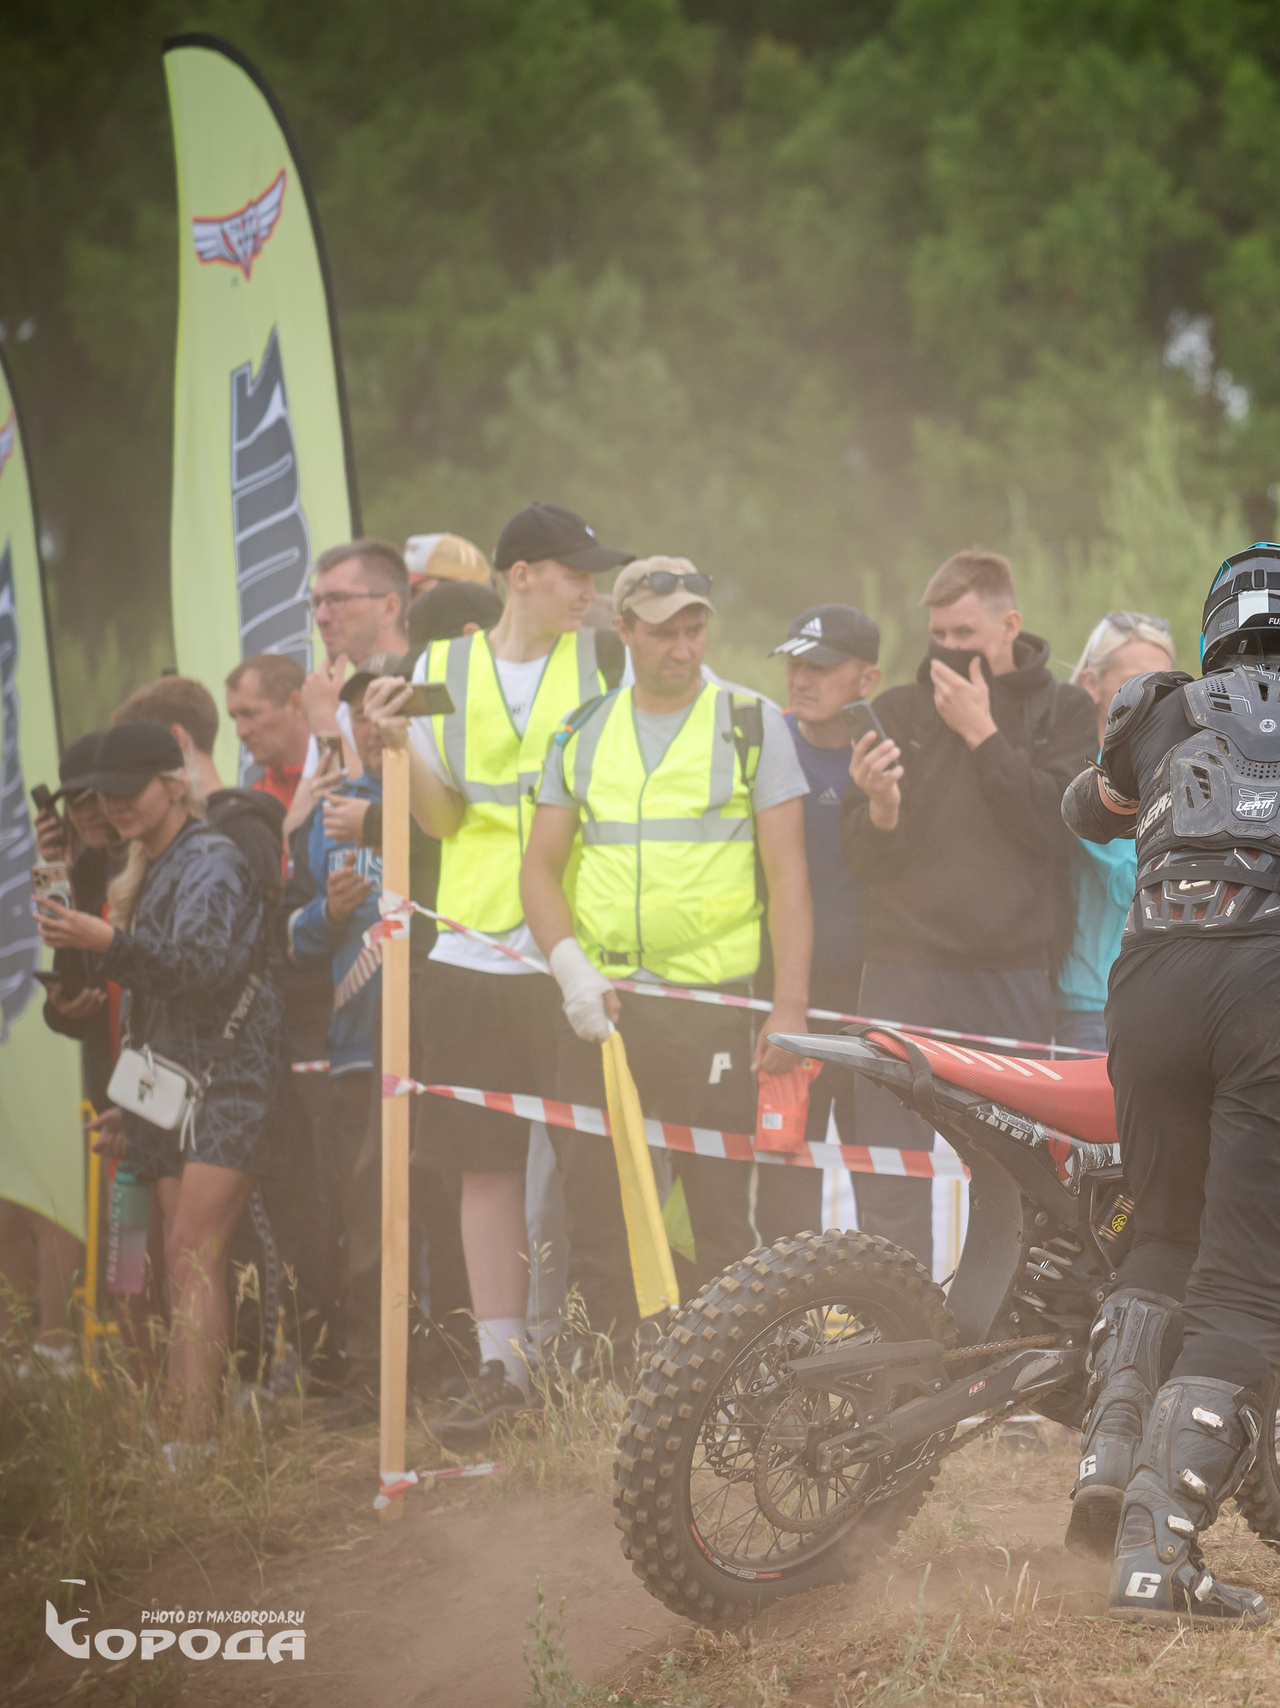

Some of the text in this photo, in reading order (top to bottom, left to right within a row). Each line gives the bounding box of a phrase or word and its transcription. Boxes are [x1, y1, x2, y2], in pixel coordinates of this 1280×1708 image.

[1236, 800, 1275, 811] LEATT
[1079, 1454, 1097, 1482] G
[1125, 1571, 1163, 1599] G
